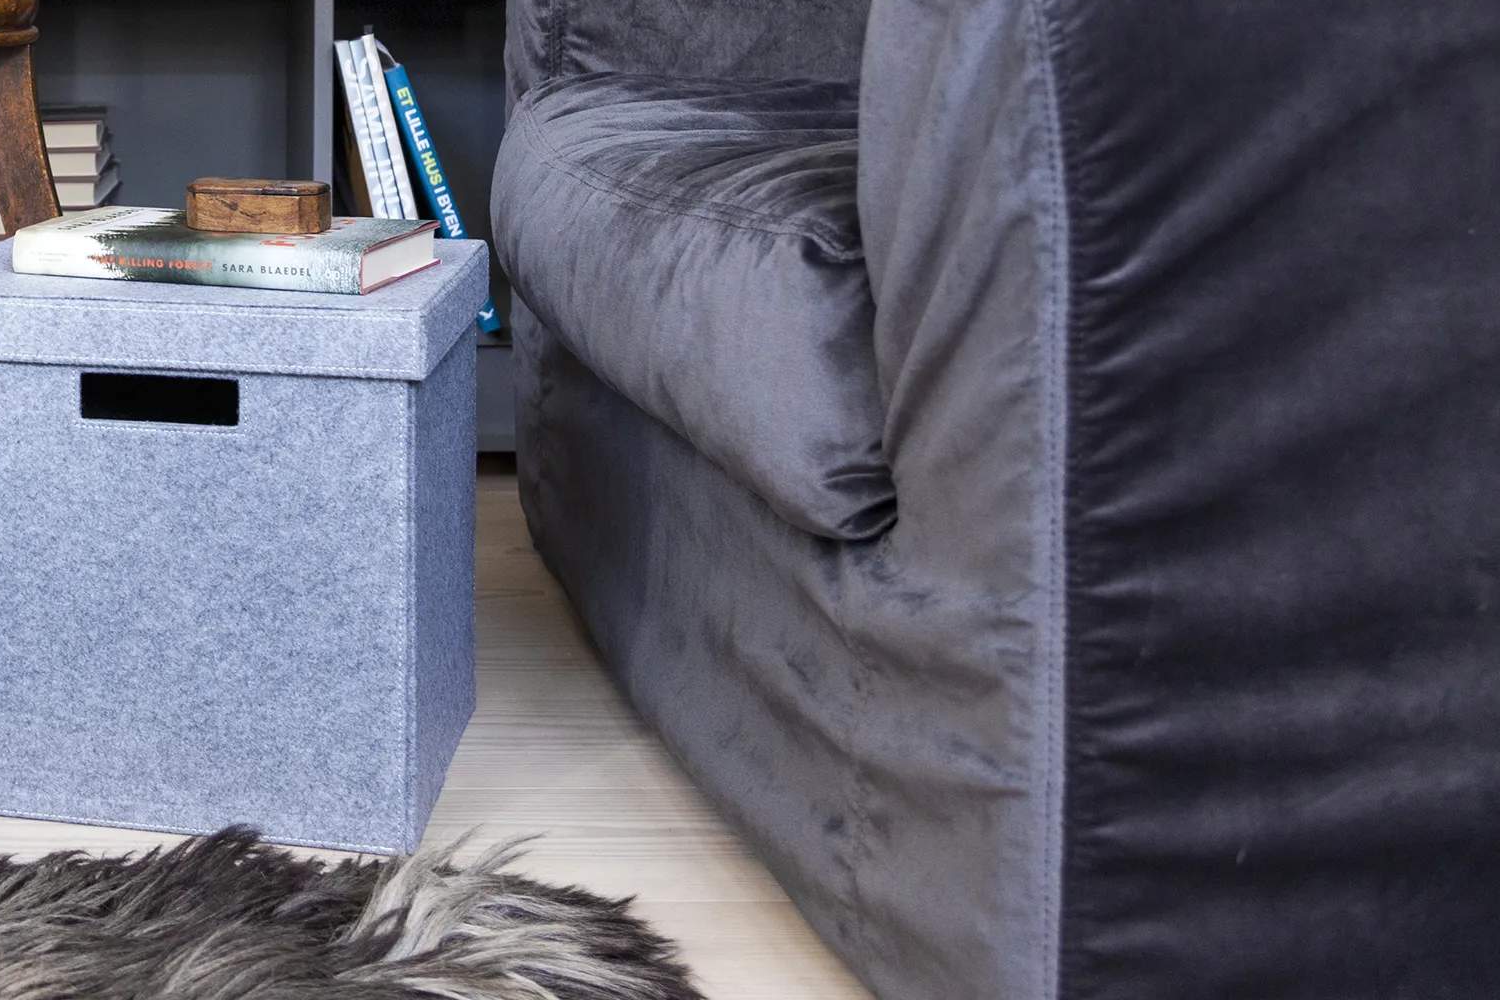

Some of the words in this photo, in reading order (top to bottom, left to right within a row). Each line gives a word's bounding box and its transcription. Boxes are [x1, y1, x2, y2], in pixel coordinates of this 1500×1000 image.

[396, 87, 414, 106] ET
[405, 109, 430, 151] LILLE
[420, 151, 442, 186] HUS
[434, 186, 447, 194] I
[436, 195, 462, 237] BYEN
[221, 263, 254, 274] SARA
[260, 265, 312, 277] BLAEDEL
